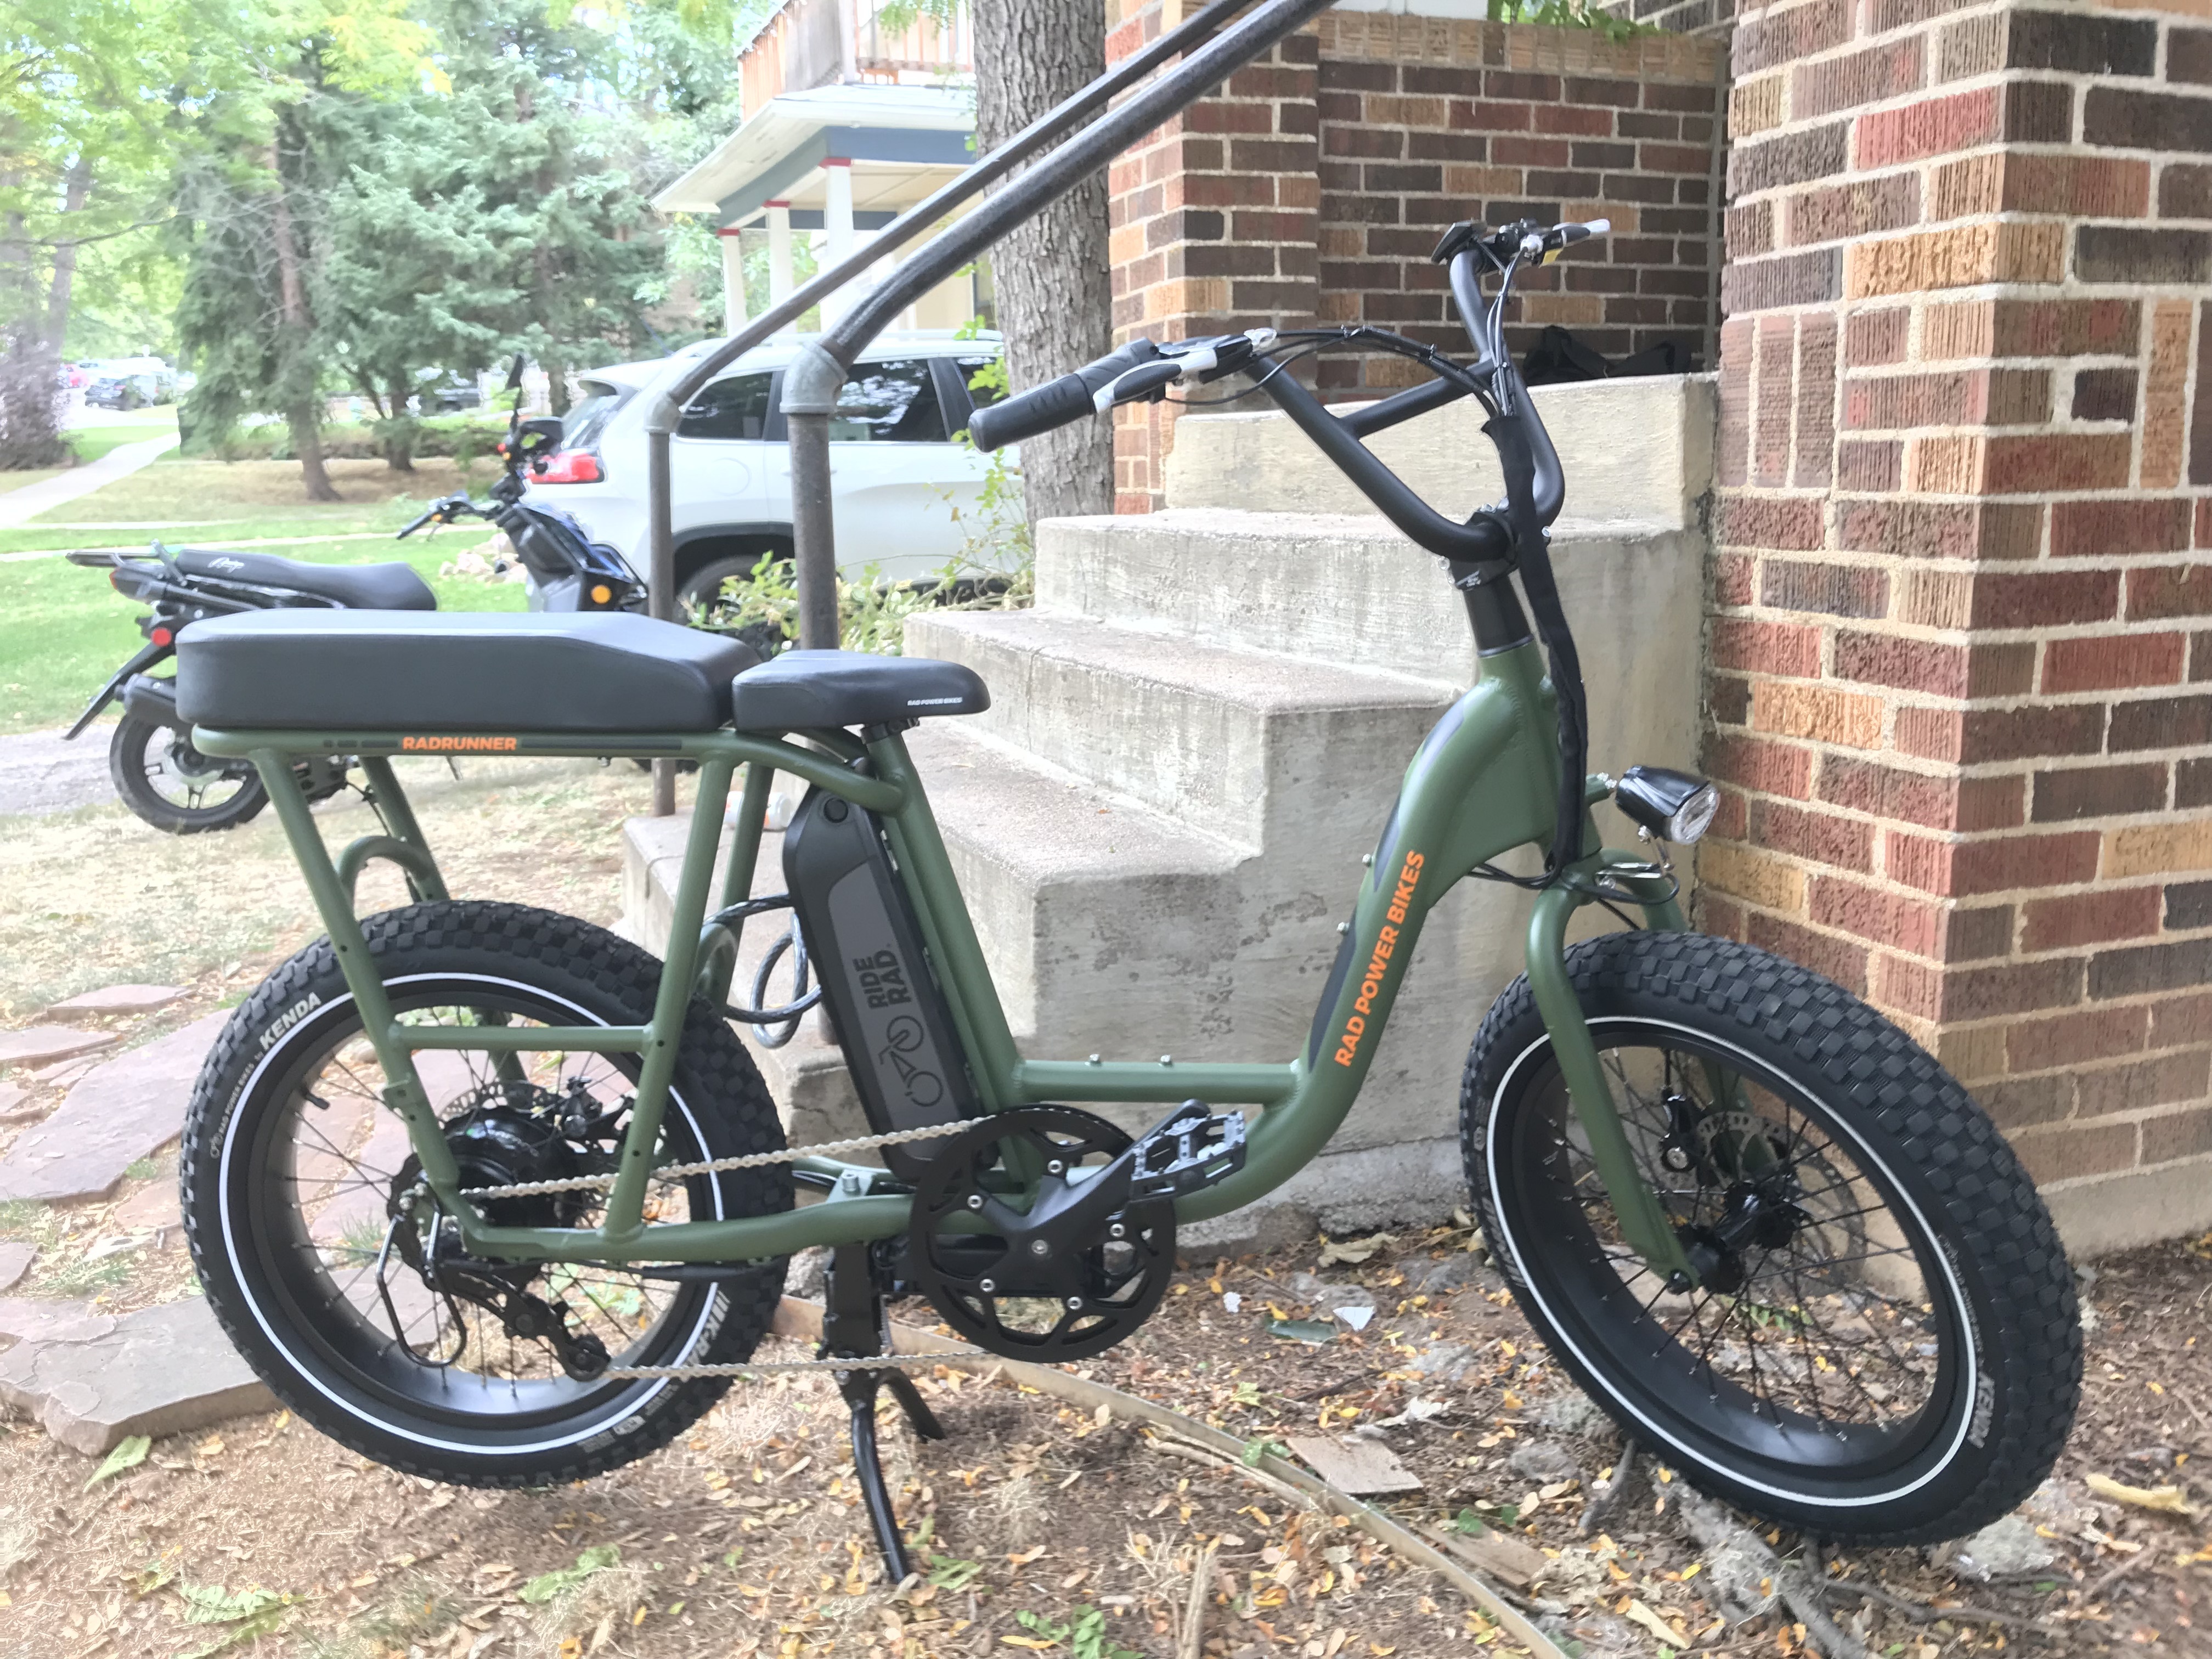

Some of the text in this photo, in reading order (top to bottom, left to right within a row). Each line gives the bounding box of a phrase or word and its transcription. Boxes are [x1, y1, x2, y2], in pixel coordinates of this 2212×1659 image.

[402, 736, 517, 751] RADRUNNER
[853, 956, 888, 1009] RIDE
[874, 949, 912, 1005] RAD
[1334, 849, 1425, 1067] RAD POWER BIKES
[258, 991, 321, 1051] KENDA
